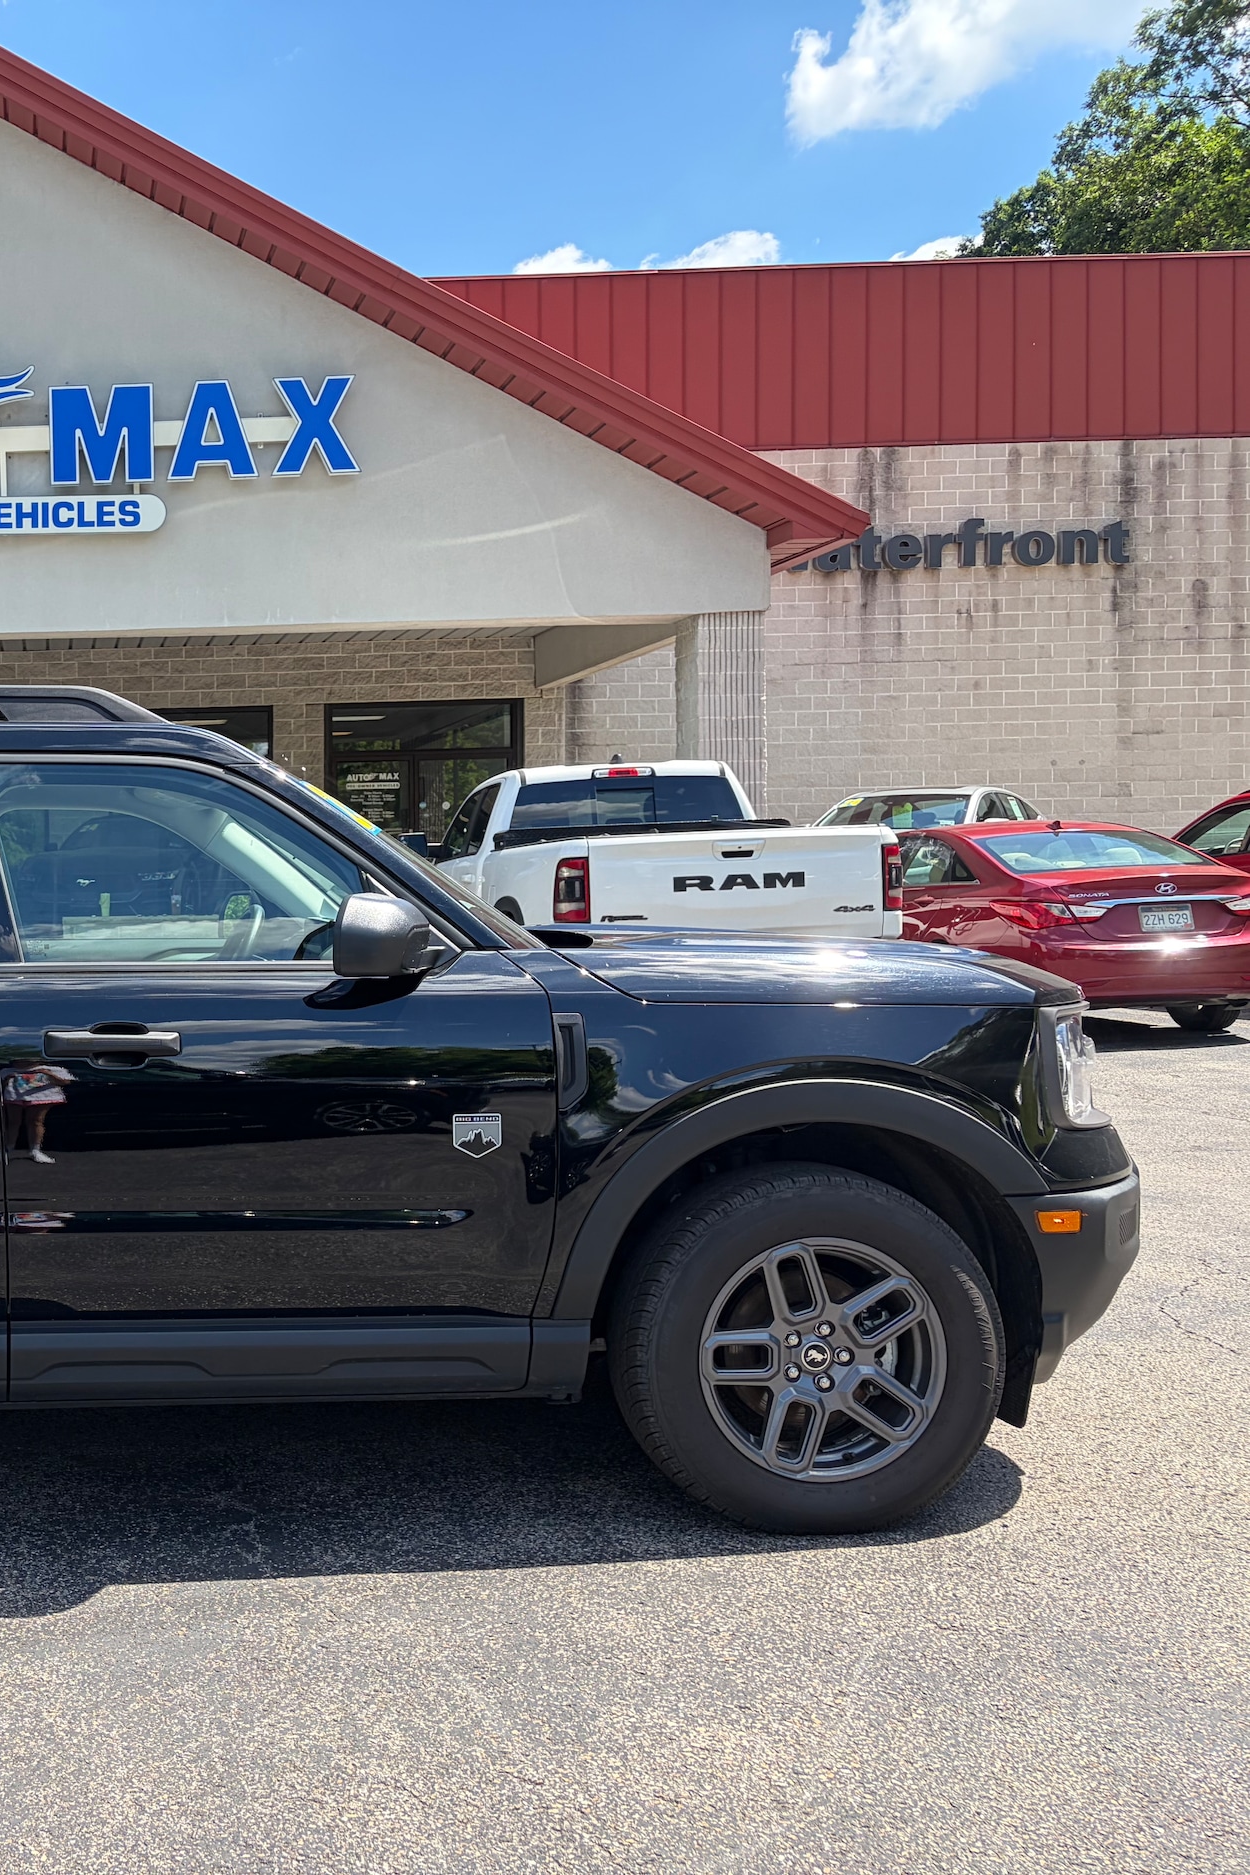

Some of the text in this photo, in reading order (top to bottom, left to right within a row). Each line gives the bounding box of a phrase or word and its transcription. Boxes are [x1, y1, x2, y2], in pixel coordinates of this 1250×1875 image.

[48, 374, 362, 487] MAX
[788, 518, 1132, 573] aterfront
[346, 772, 400, 782] AUTO MAX
[673, 871, 806, 892] RAM
[1168, 913, 1189, 925] 629
